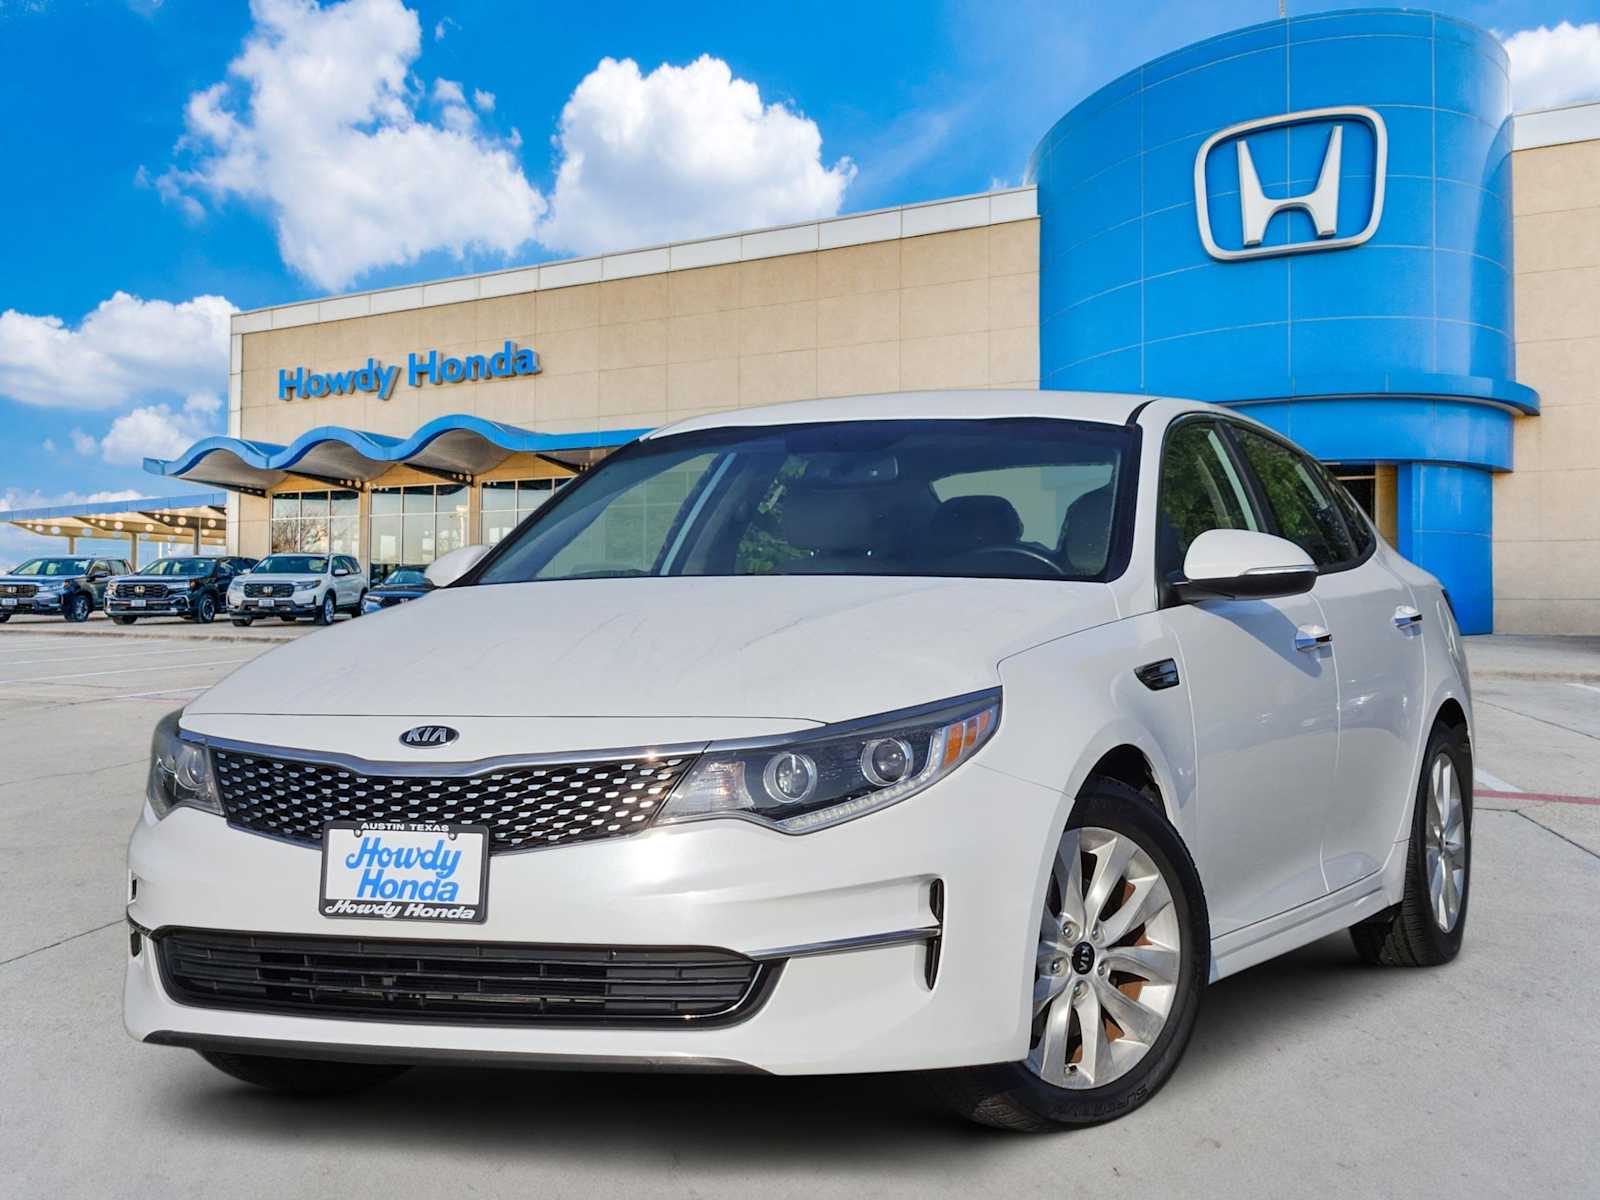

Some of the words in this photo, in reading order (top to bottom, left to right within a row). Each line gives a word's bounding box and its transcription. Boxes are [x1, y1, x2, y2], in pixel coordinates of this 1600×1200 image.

[278, 357, 401, 401] Howdy
[408, 341, 541, 387] Honda
[406, 727, 447, 742] KIA
[361, 822, 405, 831] AUSTIN
[409, 823, 450, 832] TEXAS
[345, 837, 463, 879] Howdy
[357, 869, 460, 901] Honda
[325, 900, 401, 918] Howdy
[404, 903, 476, 919] Honda
